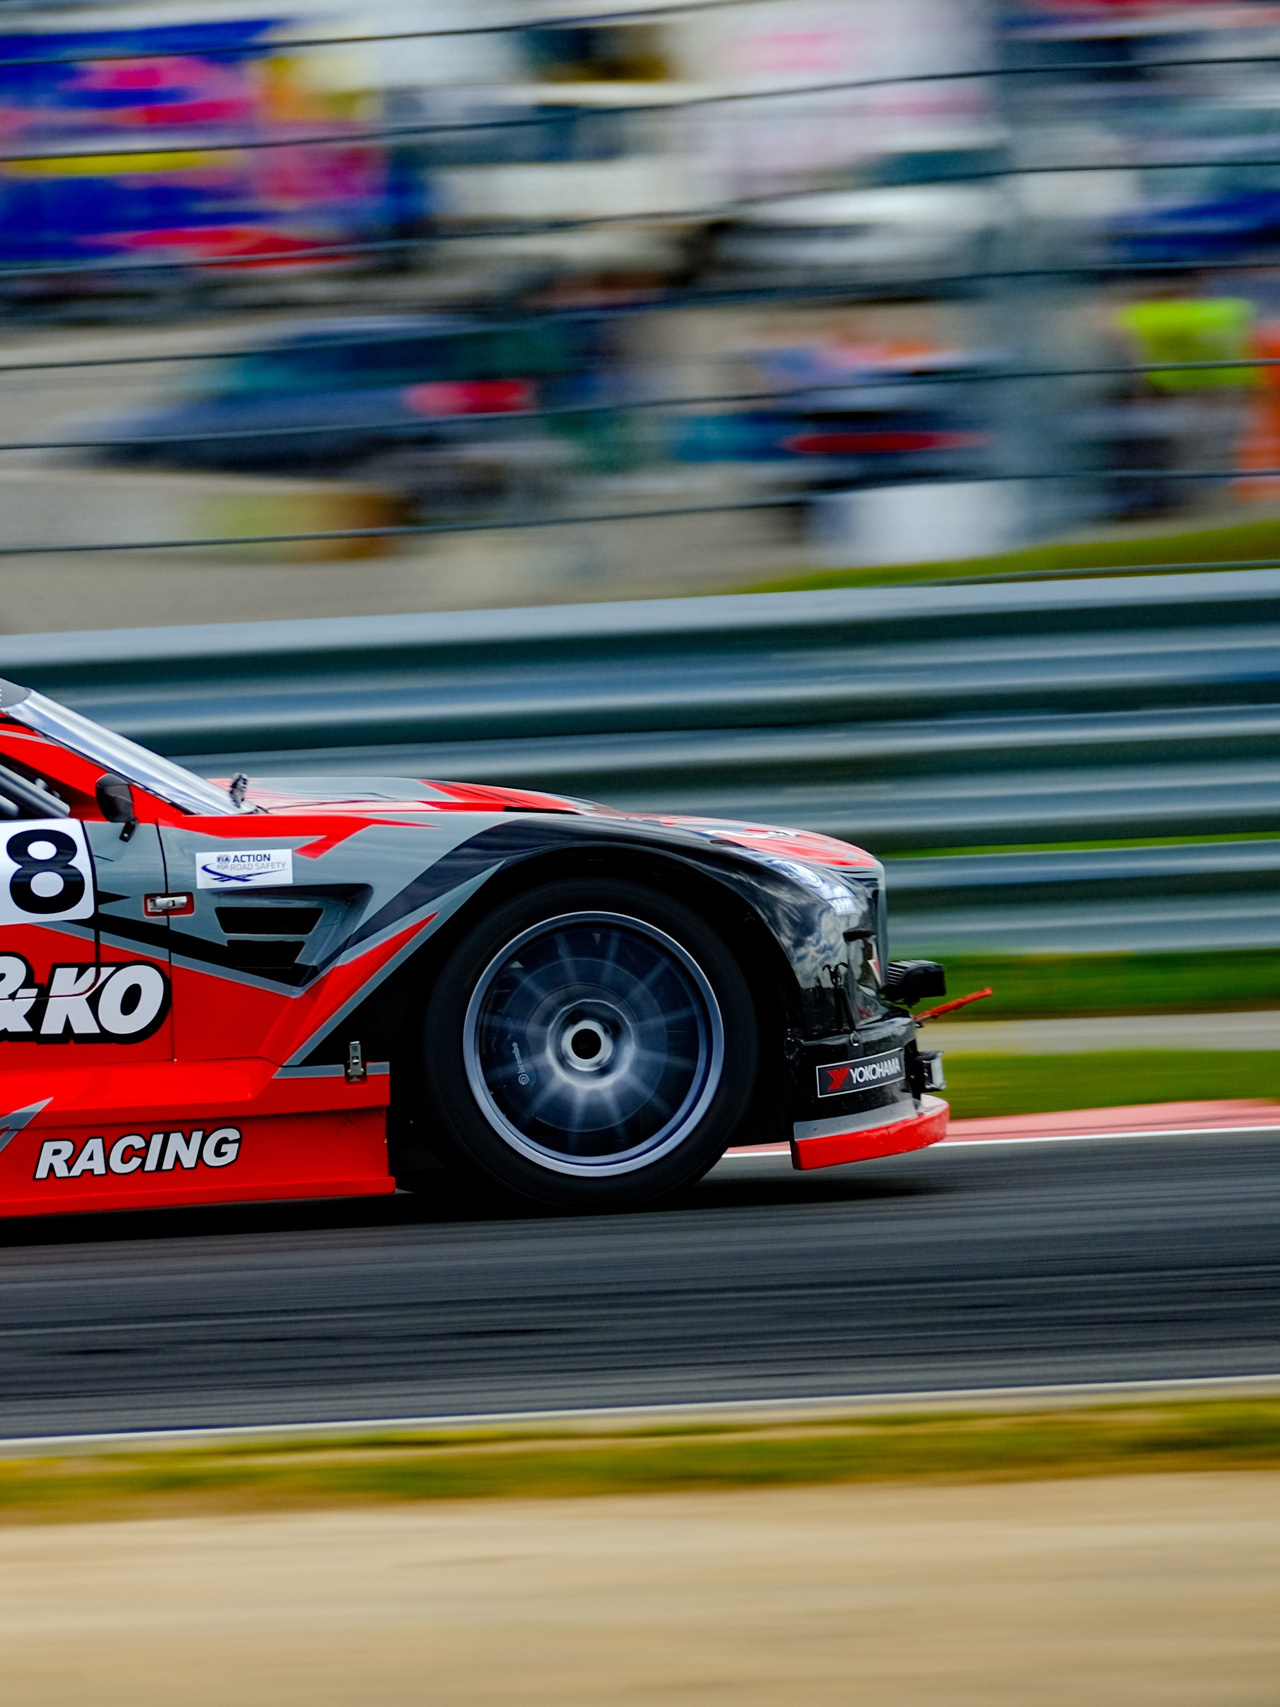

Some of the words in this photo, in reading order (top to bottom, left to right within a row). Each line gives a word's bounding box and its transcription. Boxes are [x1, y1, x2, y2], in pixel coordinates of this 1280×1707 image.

[230, 863, 254, 871] ROAD
[255, 861, 287, 870] SAFETY
[232, 853, 271, 863] ACTION
[512, 1042, 525, 1074] brembo
[849, 1057, 901, 1084] YOKOHAMA
[34, 1127, 241, 1179] RACING
